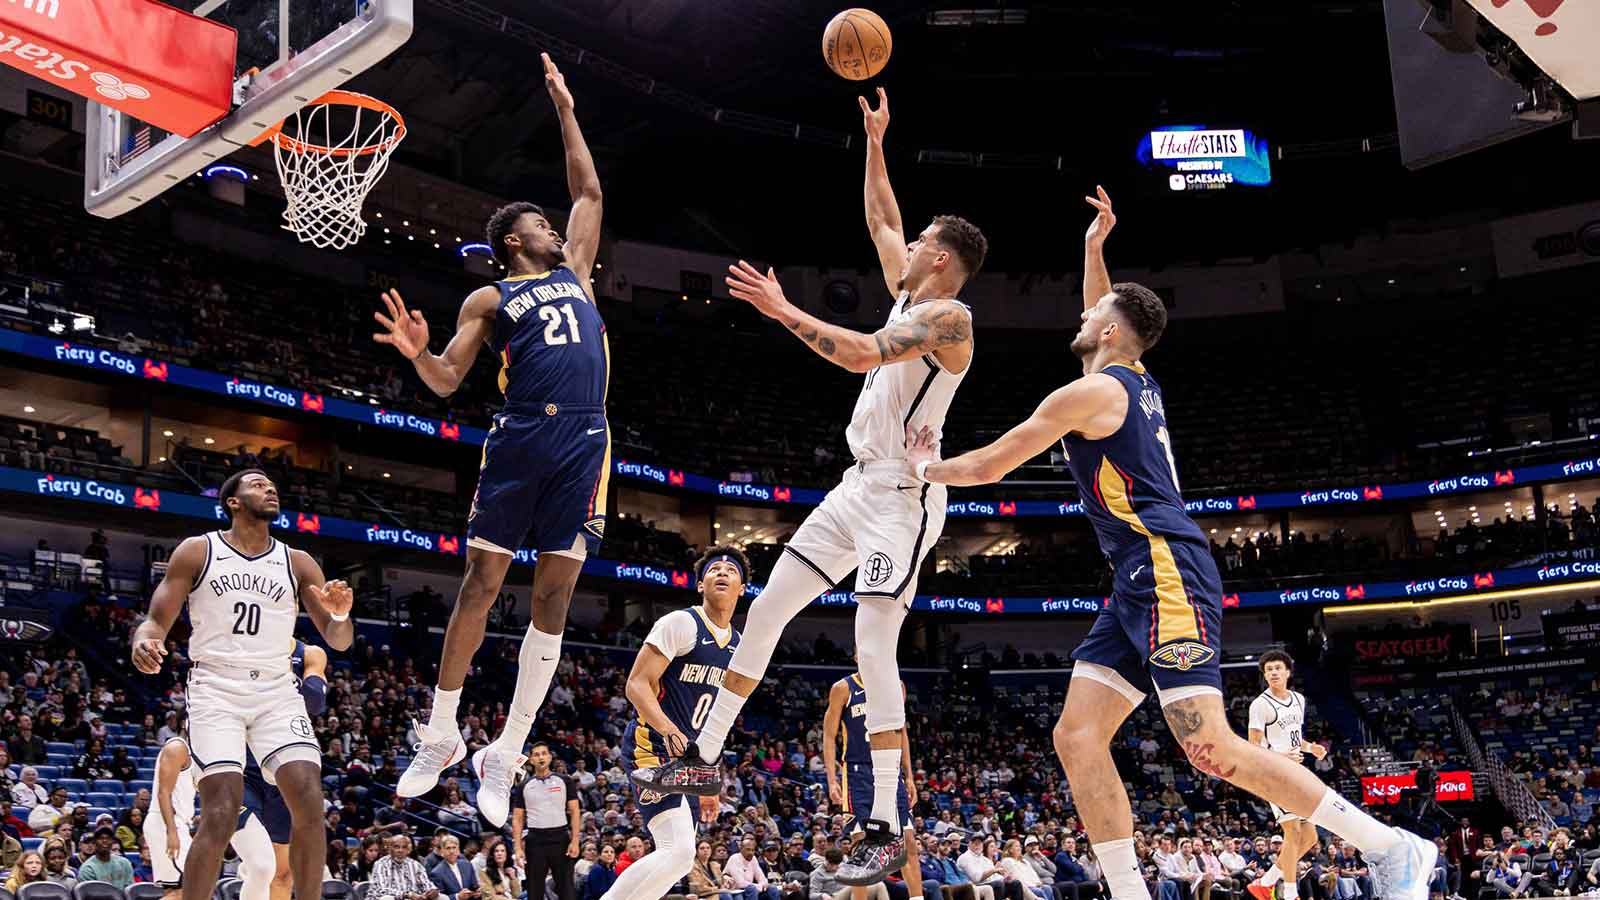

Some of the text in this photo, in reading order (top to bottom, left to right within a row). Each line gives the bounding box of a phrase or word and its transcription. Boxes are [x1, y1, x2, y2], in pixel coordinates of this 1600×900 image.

[1160, 133, 1238, 156] Hustle STATS
[1186, 173, 1234, 184] CAESARS
[503, 291, 537, 323] NEW
[538, 303, 581, 346] 21
[55, 342, 137, 374] Fiery Crab
[226, 378, 297, 407] Fiery Crab
[373, 408, 436, 435] Fiery Crab
[617, 460, 666, 482] Fiery Crab
[1563, 459, 1595, 476] Fiery
[37, 474, 126, 506] Fiery Crab
[718, 481, 770, 500] Fiery Crab
[1428, 475, 1490, 494] Fiery Crab
[1205, 498, 1233, 511] Crab
[1300, 489, 1359, 505] Fiery Crab
[968, 501, 995, 515] Crab
[366, 524, 433, 551] Fiery Crab
[616, 563, 669, 584] Fiery Crab
[1537, 563, 1570, 581] Fiery
[209, 572, 289, 604] BROOKLYN
[820, 589, 847, 604] Fiery
[1280, 587, 1340, 604] Fiery Crab
[1405, 577, 1468, 595] Fiery Crab
[929, 596, 982, 613] Fiery Crab
[1042, 597, 1099, 612] Fiery Crab
[1489, 600, 1521, 622] 105
[231, 600, 262, 637] 20
[1354, 633, 1451, 659] SEATGEEK
[680, 663, 706, 684] NEW
[691, 692, 713, 731] 0
[1290, 729, 1302, 748] 88
[1440, 782, 1466, 793] KING
